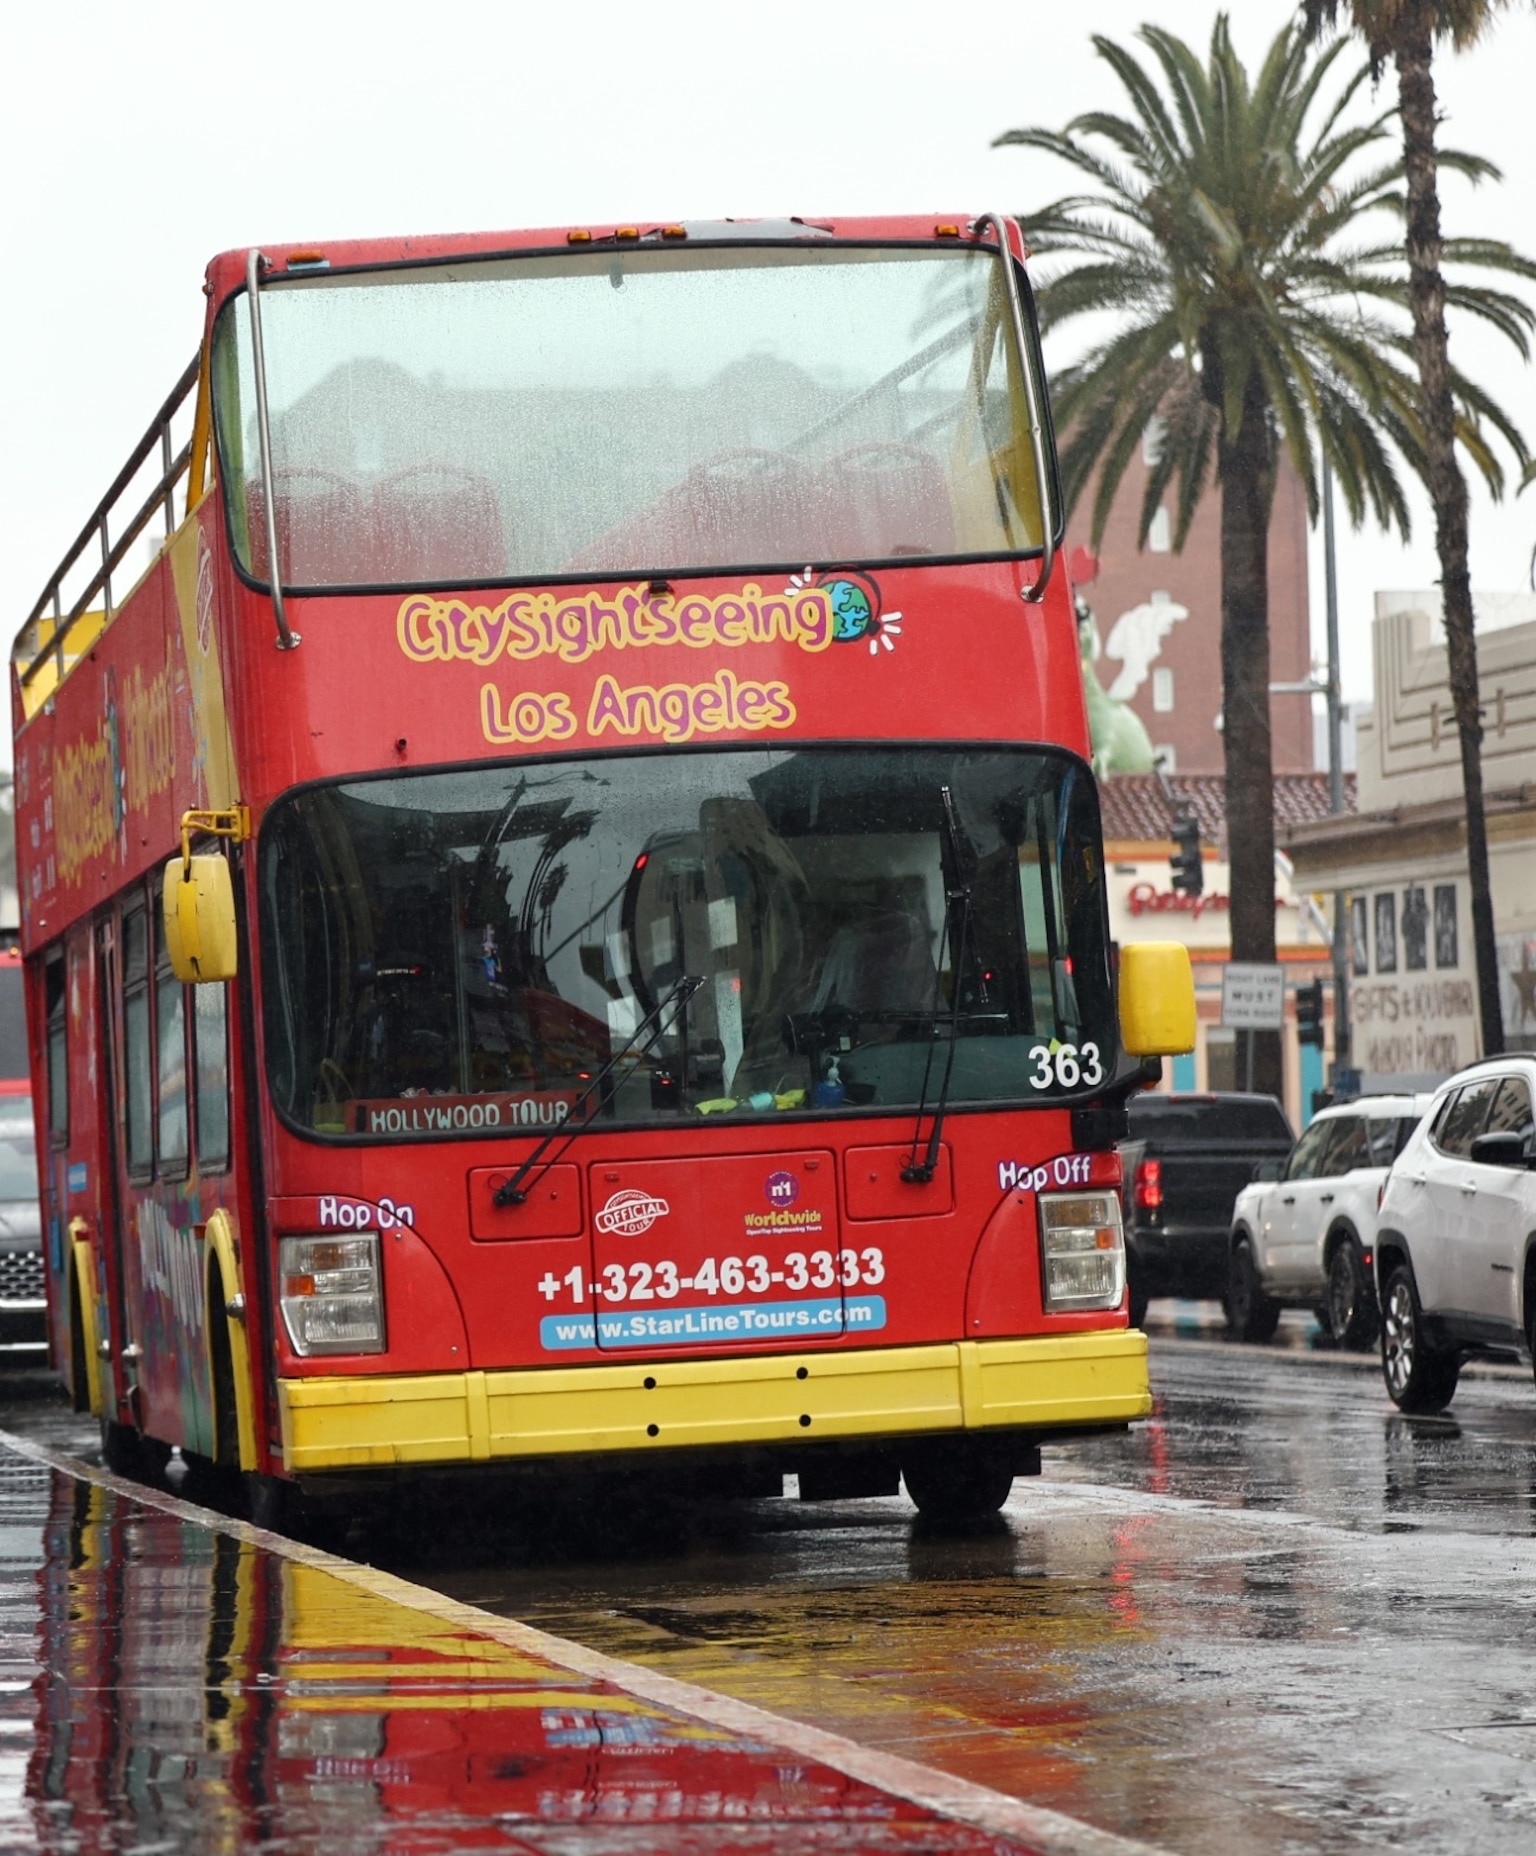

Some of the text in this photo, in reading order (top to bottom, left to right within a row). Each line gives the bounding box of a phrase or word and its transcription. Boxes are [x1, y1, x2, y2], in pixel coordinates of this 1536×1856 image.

[480, 669, 796, 744] Los Angeles
[1028, 1042, 1102, 1089] 363
[371, 1099, 570, 1133] HOLLYWOOD TOUR
[998, 1155, 1091, 1192] Hop Off
[320, 1196, 414, 1230] Hop On
[604, 1202, 662, 1227] OFFICIAL
[623, 1218, 650, 1232] TOUR
[744, 1209, 822, 1227] Worldwide
[538, 1247, 886, 1304] +1-323-463-3333
[556, 1303, 872, 1341] www.StarLineTours.com
